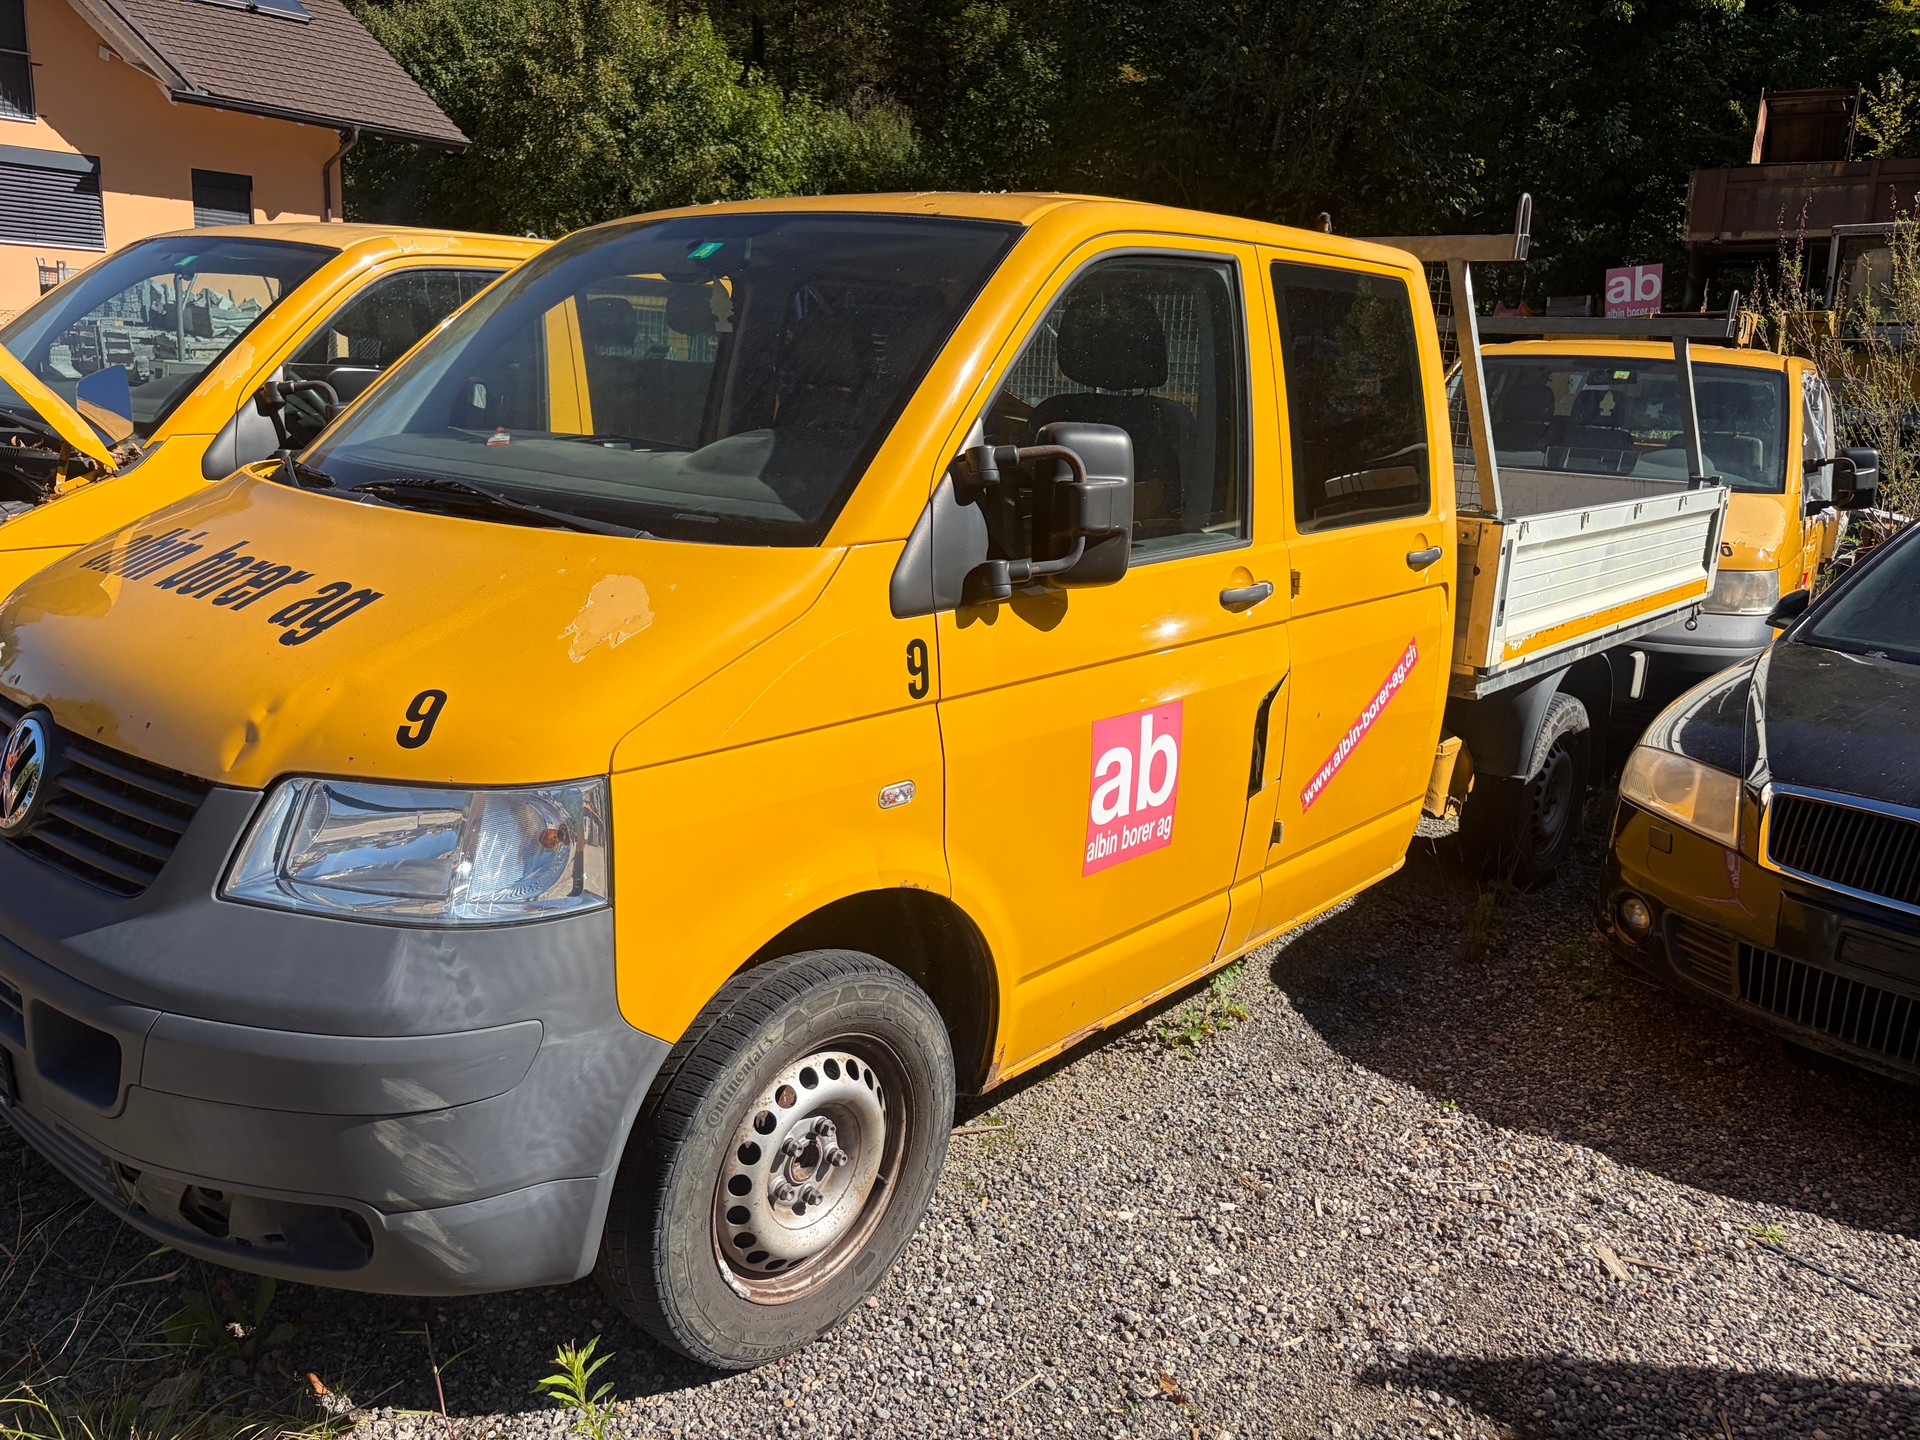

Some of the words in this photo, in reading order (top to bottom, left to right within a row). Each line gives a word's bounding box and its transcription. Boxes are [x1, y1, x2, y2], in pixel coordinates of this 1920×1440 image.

[1606, 266, 1661, 304] ab
[1626, 307, 1648, 317] borer
[153, 540, 317, 612] borer
[267, 580, 386, 647] ag
[906, 638, 930, 700] 9
[395, 688, 448, 750] 9
[1302, 644, 1418, 805] www.albin-borer-ag.ch
[1091, 713, 1178, 826] ab
[1086, 829, 1119, 863] albin
[1121, 824, 1156, 850] borer
[1156, 814, 1173, 840] ag
[706, 1043, 768, 1129] Continental
